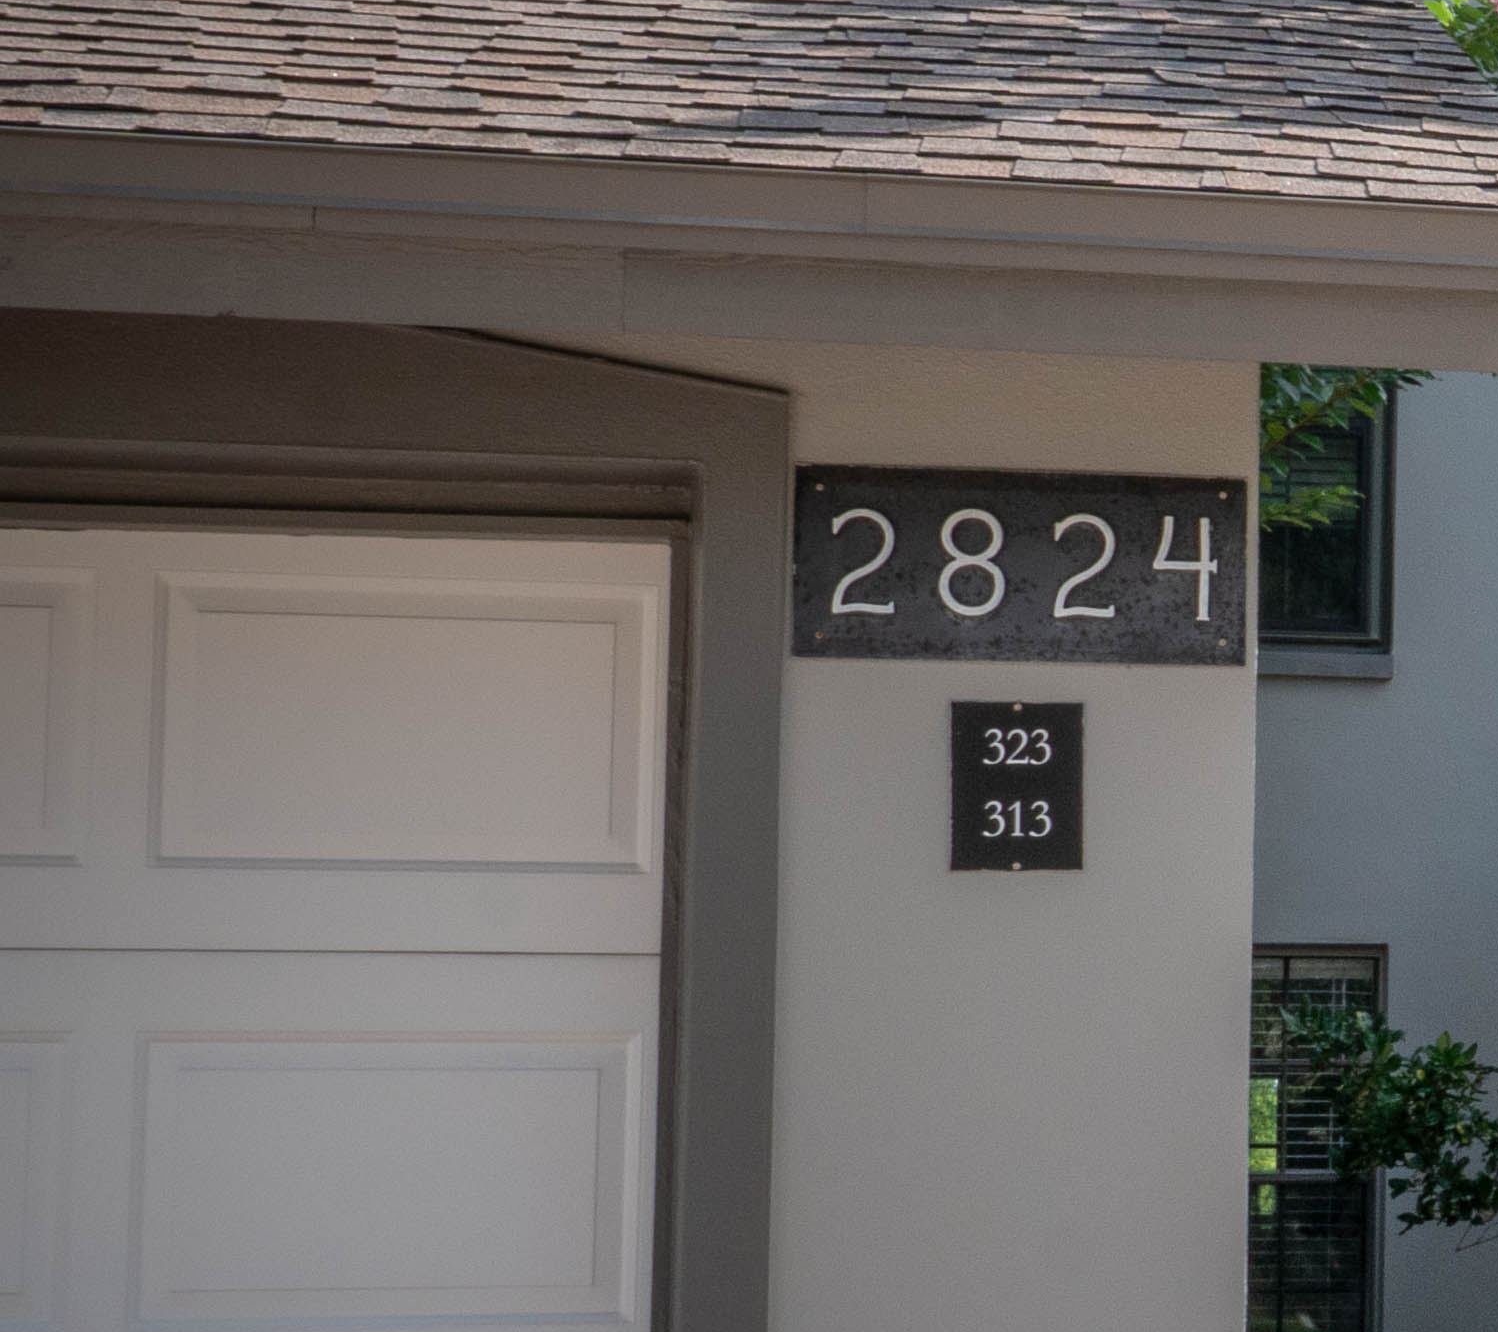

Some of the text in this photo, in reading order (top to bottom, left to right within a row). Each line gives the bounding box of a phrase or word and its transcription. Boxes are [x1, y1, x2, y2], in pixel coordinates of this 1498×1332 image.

[832, 509, 1217, 621] 2824
[982, 728, 1052, 766] 323
[982, 800, 1052, 838] 313
